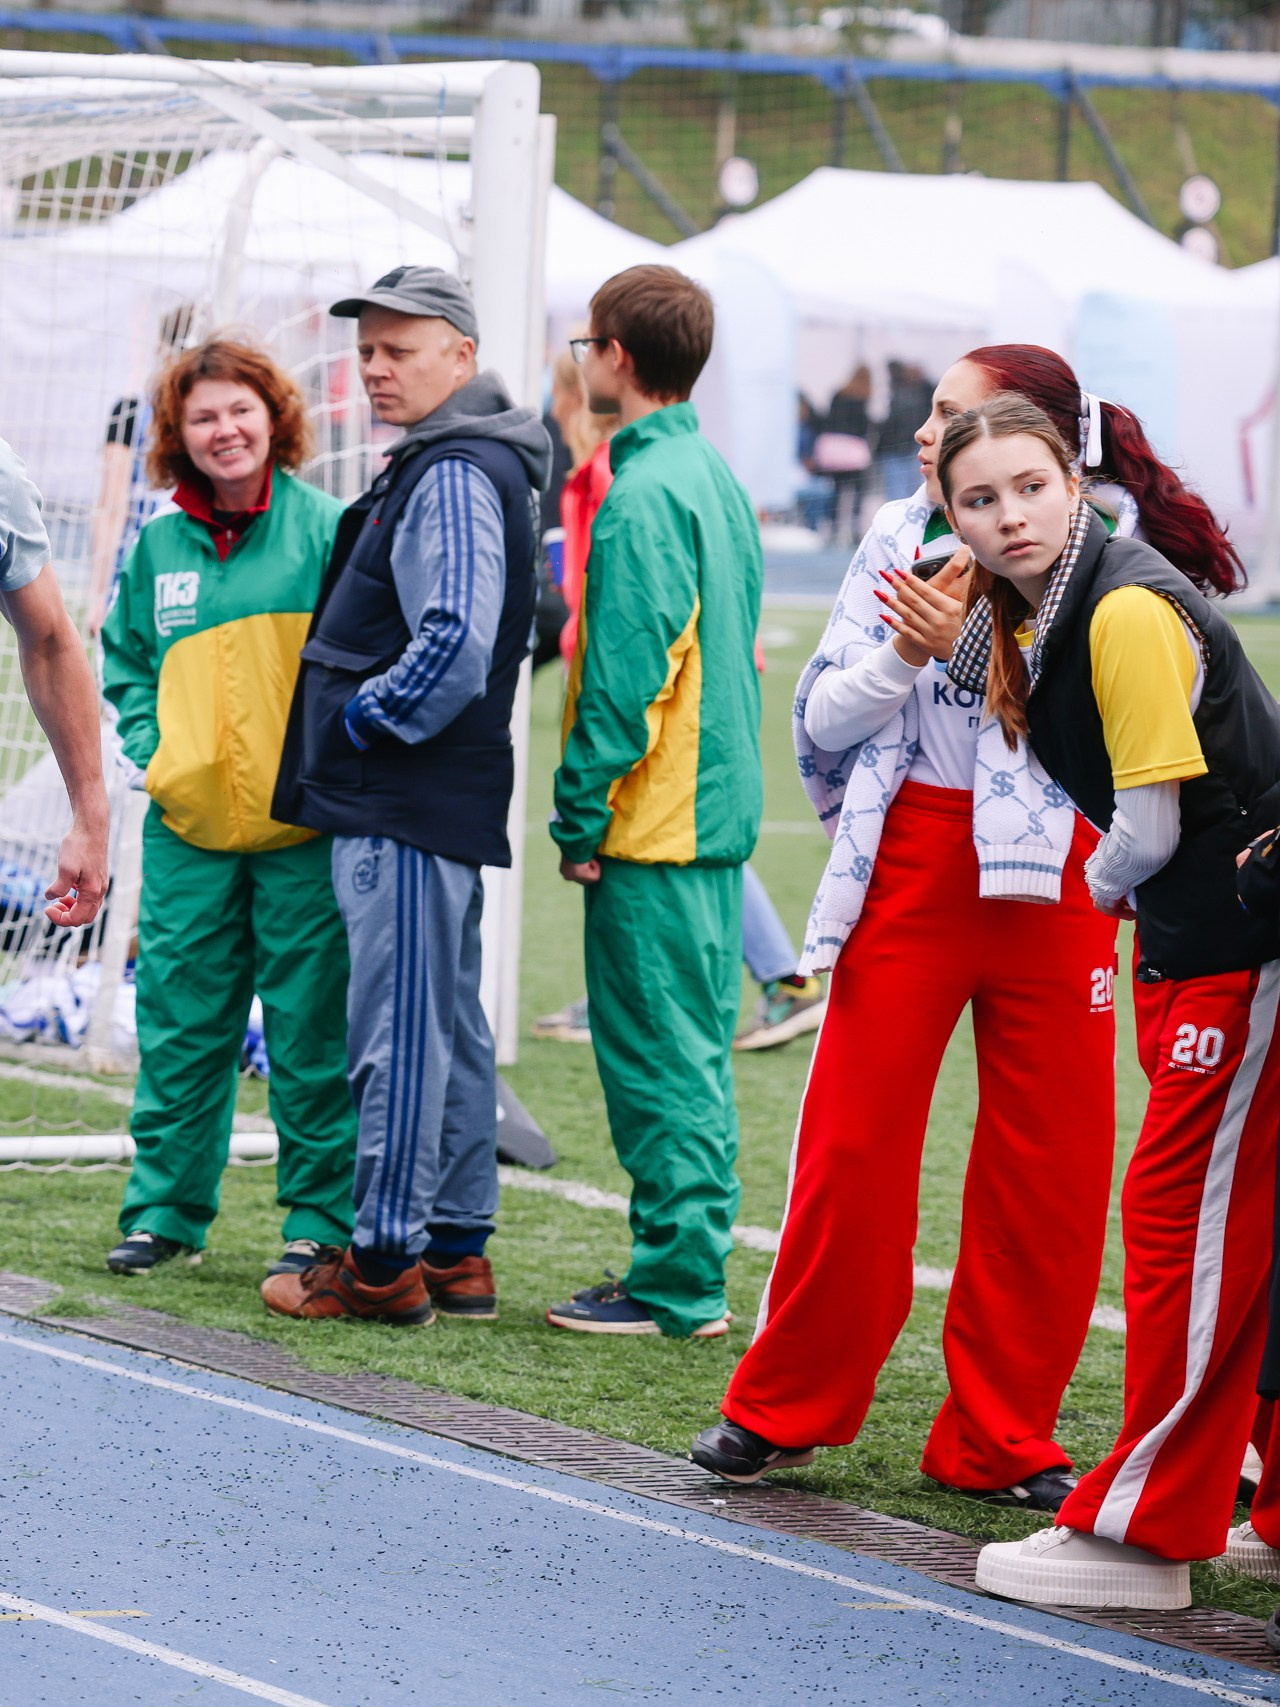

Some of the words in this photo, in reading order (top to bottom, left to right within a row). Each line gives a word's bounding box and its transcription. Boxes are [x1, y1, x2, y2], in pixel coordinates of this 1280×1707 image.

[934, 681, 983, 708] КО
[1090, 965, 1113, 1006] 20
[1171, 1022, 1226, 1067] 20
